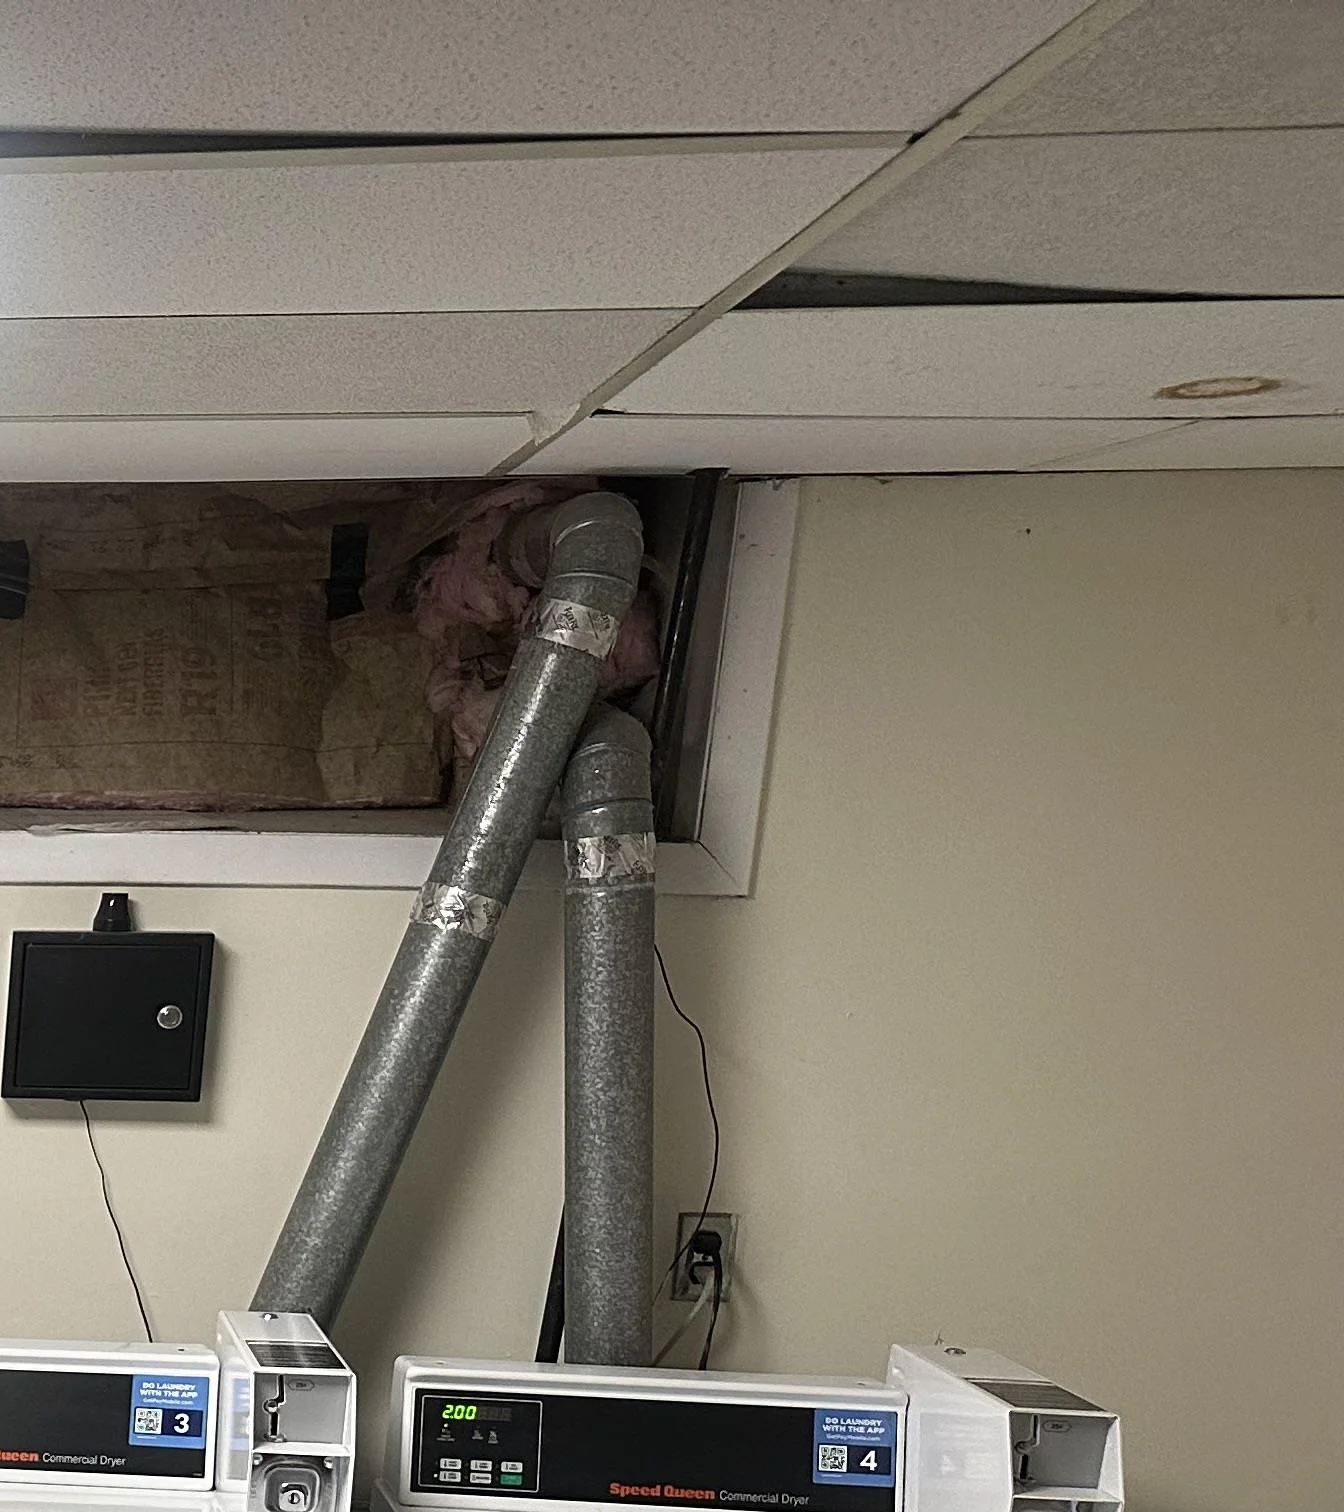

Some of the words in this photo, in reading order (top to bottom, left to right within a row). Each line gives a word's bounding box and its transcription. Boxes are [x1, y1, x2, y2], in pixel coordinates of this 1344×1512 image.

[139, 1389, 163, 1397] WITH
[164, 1389, 180, 1398] THE
[181, 1391, 198, 1399] APP
[142, 1382, 155, 1390] DO
[156, 1382, 196, 1391] LAUNDRY
[442, 1404, 477, 1420] 2.00
[173, 1413, 190, 1434] 3
[822, 1424, 846, 1433] WITH
[848, 1425, 866, 1434] THE
[866, 1426, 885, 1435] APP
[825, 1417, 838, 1425] DO
[840, 1417, 883, 1428] LAUNDRY
[42, 1452, 98, 1465] Commercial
[99, 1454, 126, 1468] Dryer
[859, 1450, 878, 1471] 4
[610, 1482, 661, 1499] Speed
[663, 1485, 715, 1500] Queen
[719, 1490, 779, 1504] Commercial
[781, 1491, 810, 1506] Dryer
